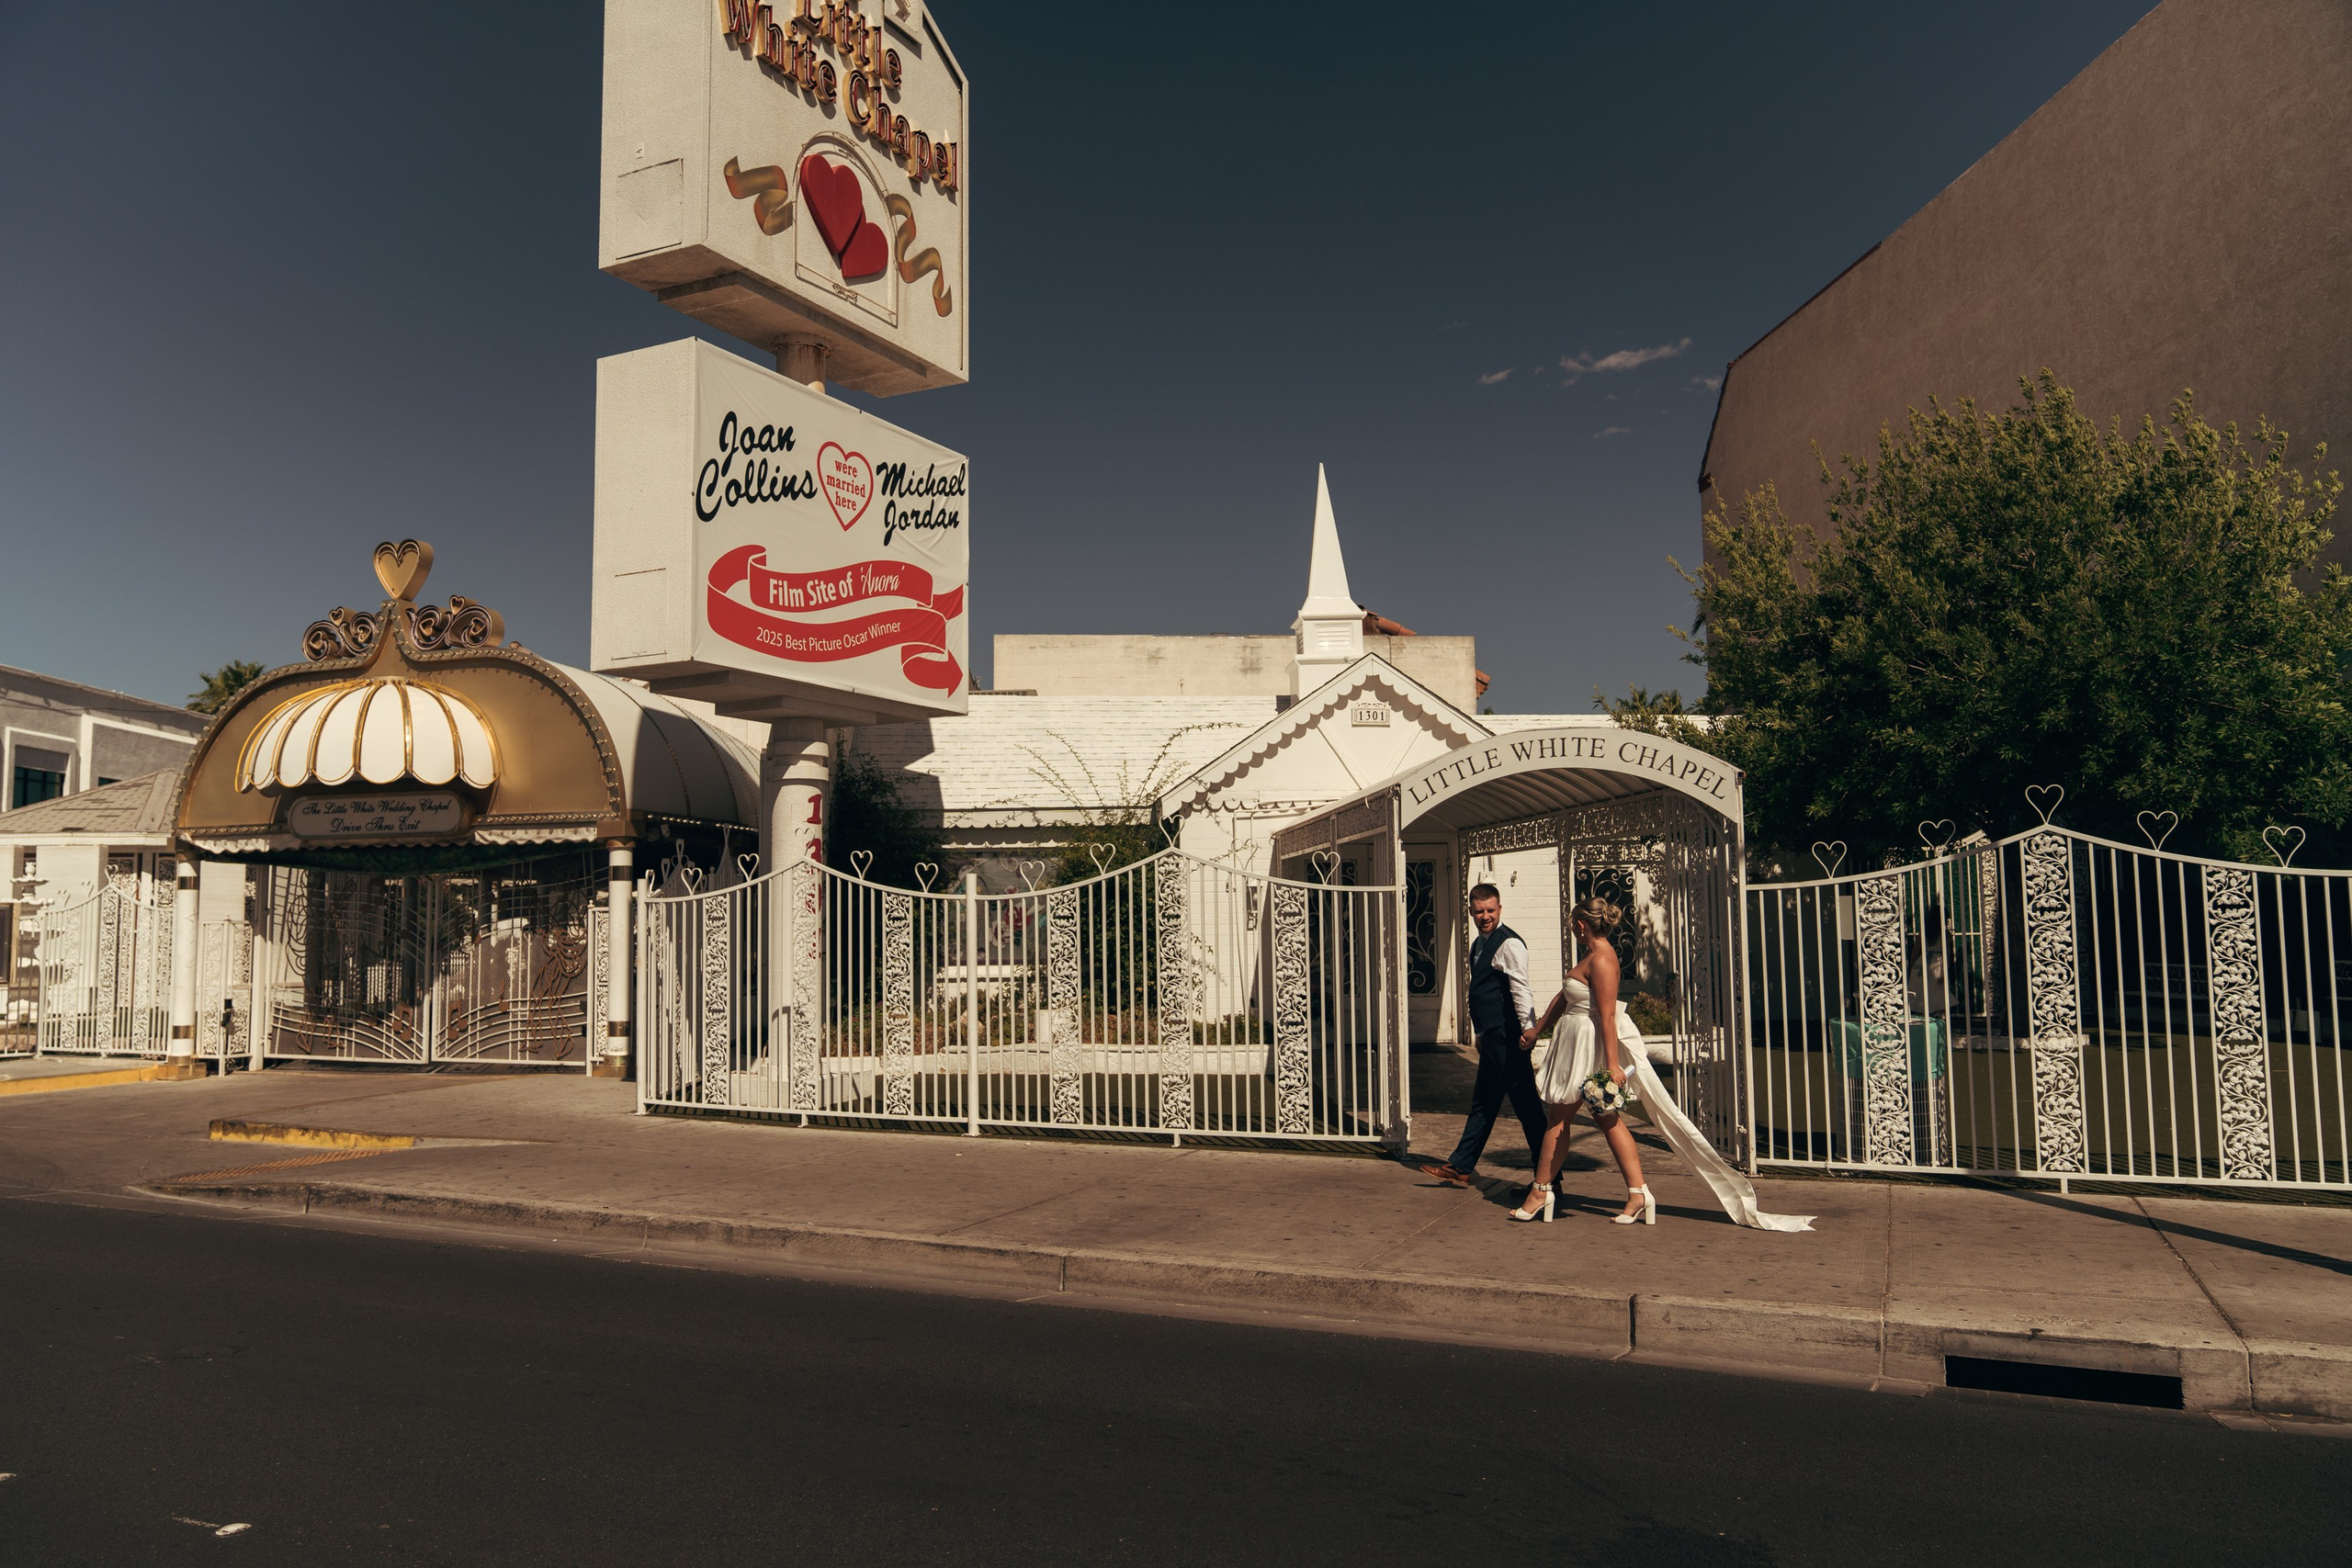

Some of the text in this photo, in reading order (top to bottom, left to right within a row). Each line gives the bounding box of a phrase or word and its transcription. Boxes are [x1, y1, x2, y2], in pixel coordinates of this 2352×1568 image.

[720, 0, 837, 104] White
[842, 69, 958, 191] Chapel
[719, 411, 796, 477] Joan
[826, 474, 865, 498] married
[834, 459, 858, 478] were
[876, 461, 967, 498] Michael
[695, 457, 818, 523] Collins
[835, 491, 856, 512] here
[884, 499, 959, 547] Jordan
[769, 578, 805, 607] Film
[807, 579, 837, 606] Site
[839, 571, 854, 597] of
[756, 622, 901, 651] 2025 Best Picture Oscar Winner
[1359, 710, 1385, 721] 1301
[1407, 737, 1727, 806] LITTLE WHITE CHAPEL
[302, 797, 452, 816] The Little White Wedding Chapel
[330, 816, 421, 833] Drive Thru Exit
